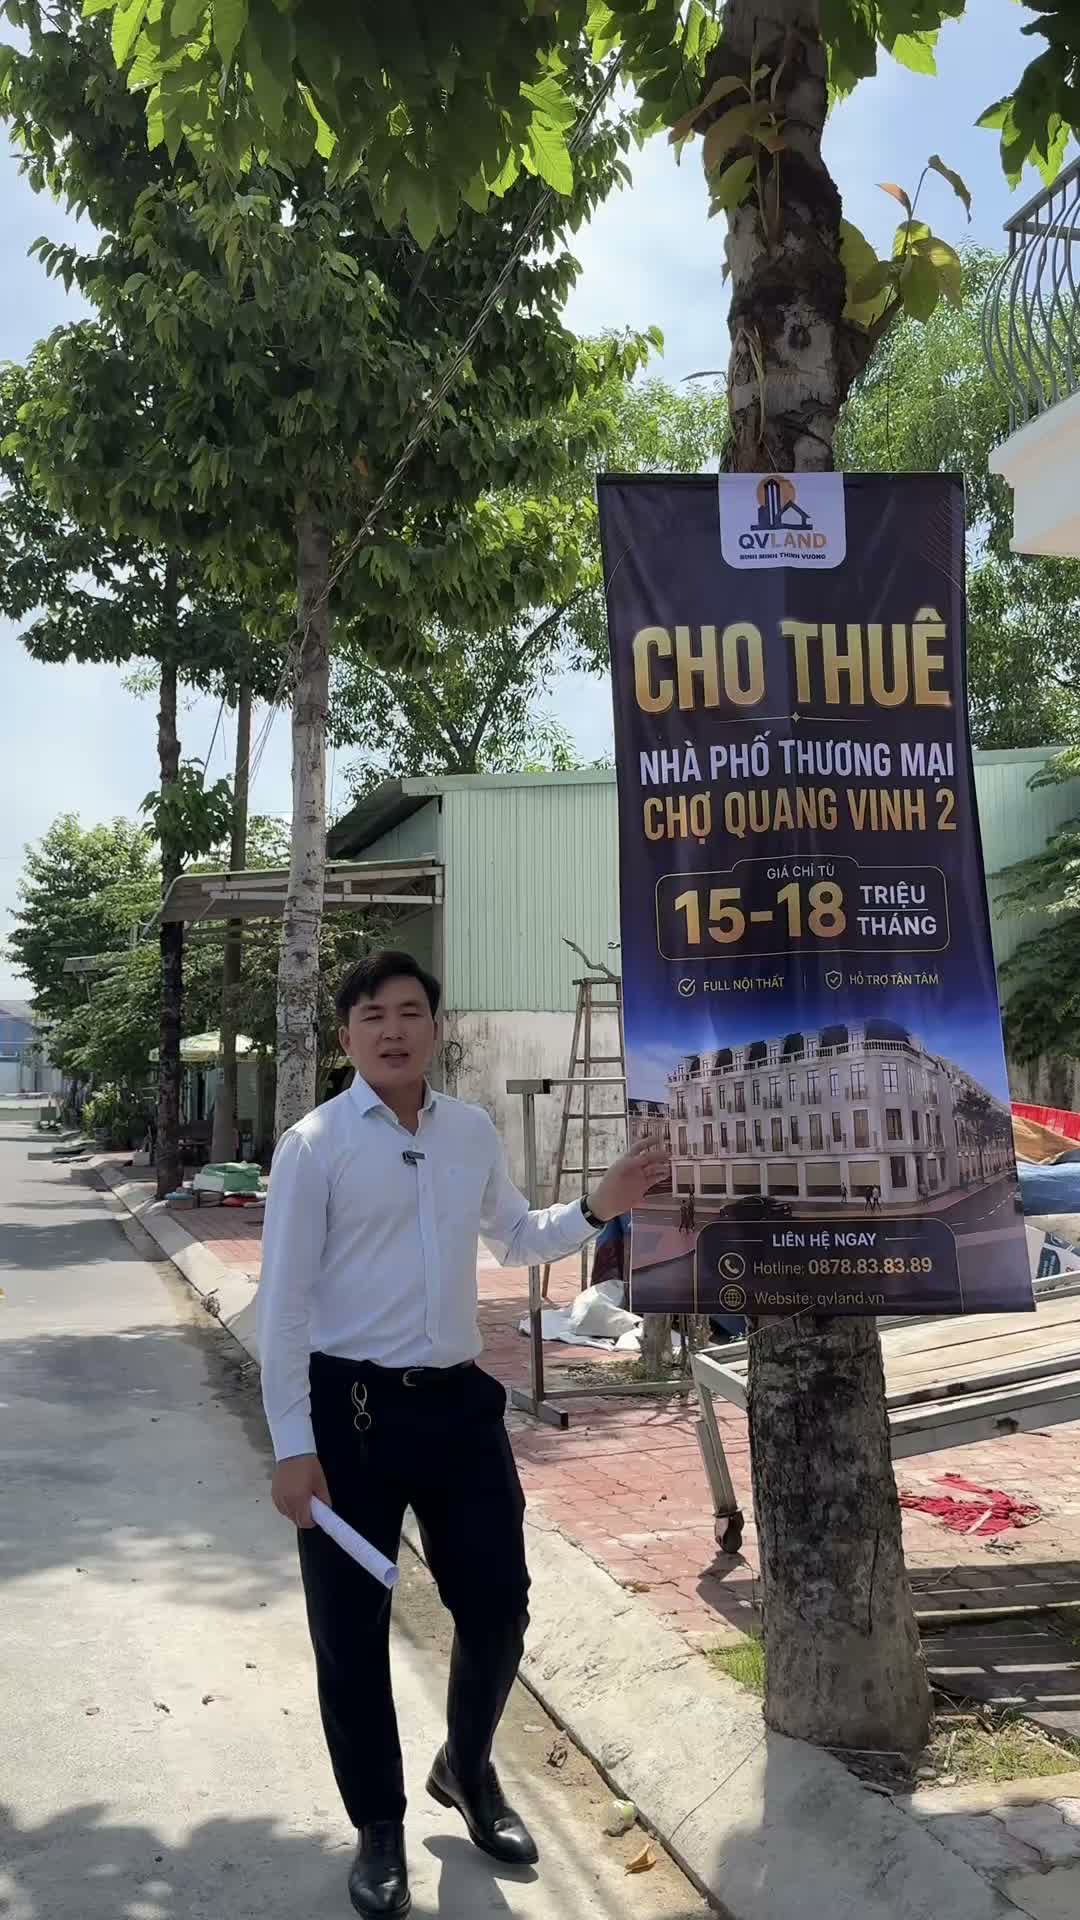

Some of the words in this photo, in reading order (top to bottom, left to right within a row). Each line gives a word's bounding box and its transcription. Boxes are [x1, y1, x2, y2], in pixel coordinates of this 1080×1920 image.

[739, 533, 827, 549] QVLAND
[632, 622, 765, 713] CHO
[779, 607, 951, 709] THUÊ
[639, 740, 702, 785] NHÀ
[710, 730, 770, 780] PHỐ
[778, 739, 891, 777] THƯƠNG
[900, 742, 955, 783] MẠI
[643, 791, 712, 845] CHỢ
[724, 787, 838, 838] QUANG
[847, 788, 926, 831] VINH
[936, 788, 957, 831] 2
[767, 864, 789, 880] GIÁ
[860, 881, 926, 908] TRIỆU
[674, 881, 847, 944] 15-18
[856, 912, 937, 936] THÁNG
[703, 980, 731, 992] FULL
[733, 976, 753, 992] NỘI
[755, 974, 785, 988] THẤT
[890, 972, 912, 988] TẬN
[914, 971, 939, 985] TÂM
[772, 1231, 805, 1247] LIÊN
[810, 1231, 829, 1249] HỆ
[834, 1233, 877, 1247] NGAY
[753, 1260, 804, 1275] Hotline:
[808, 1257, 933, 1275] 0878.83.83.89
[754, 1291, 813, 1305] Website:
[817, 1290, 885, 1308] qvland.vn
